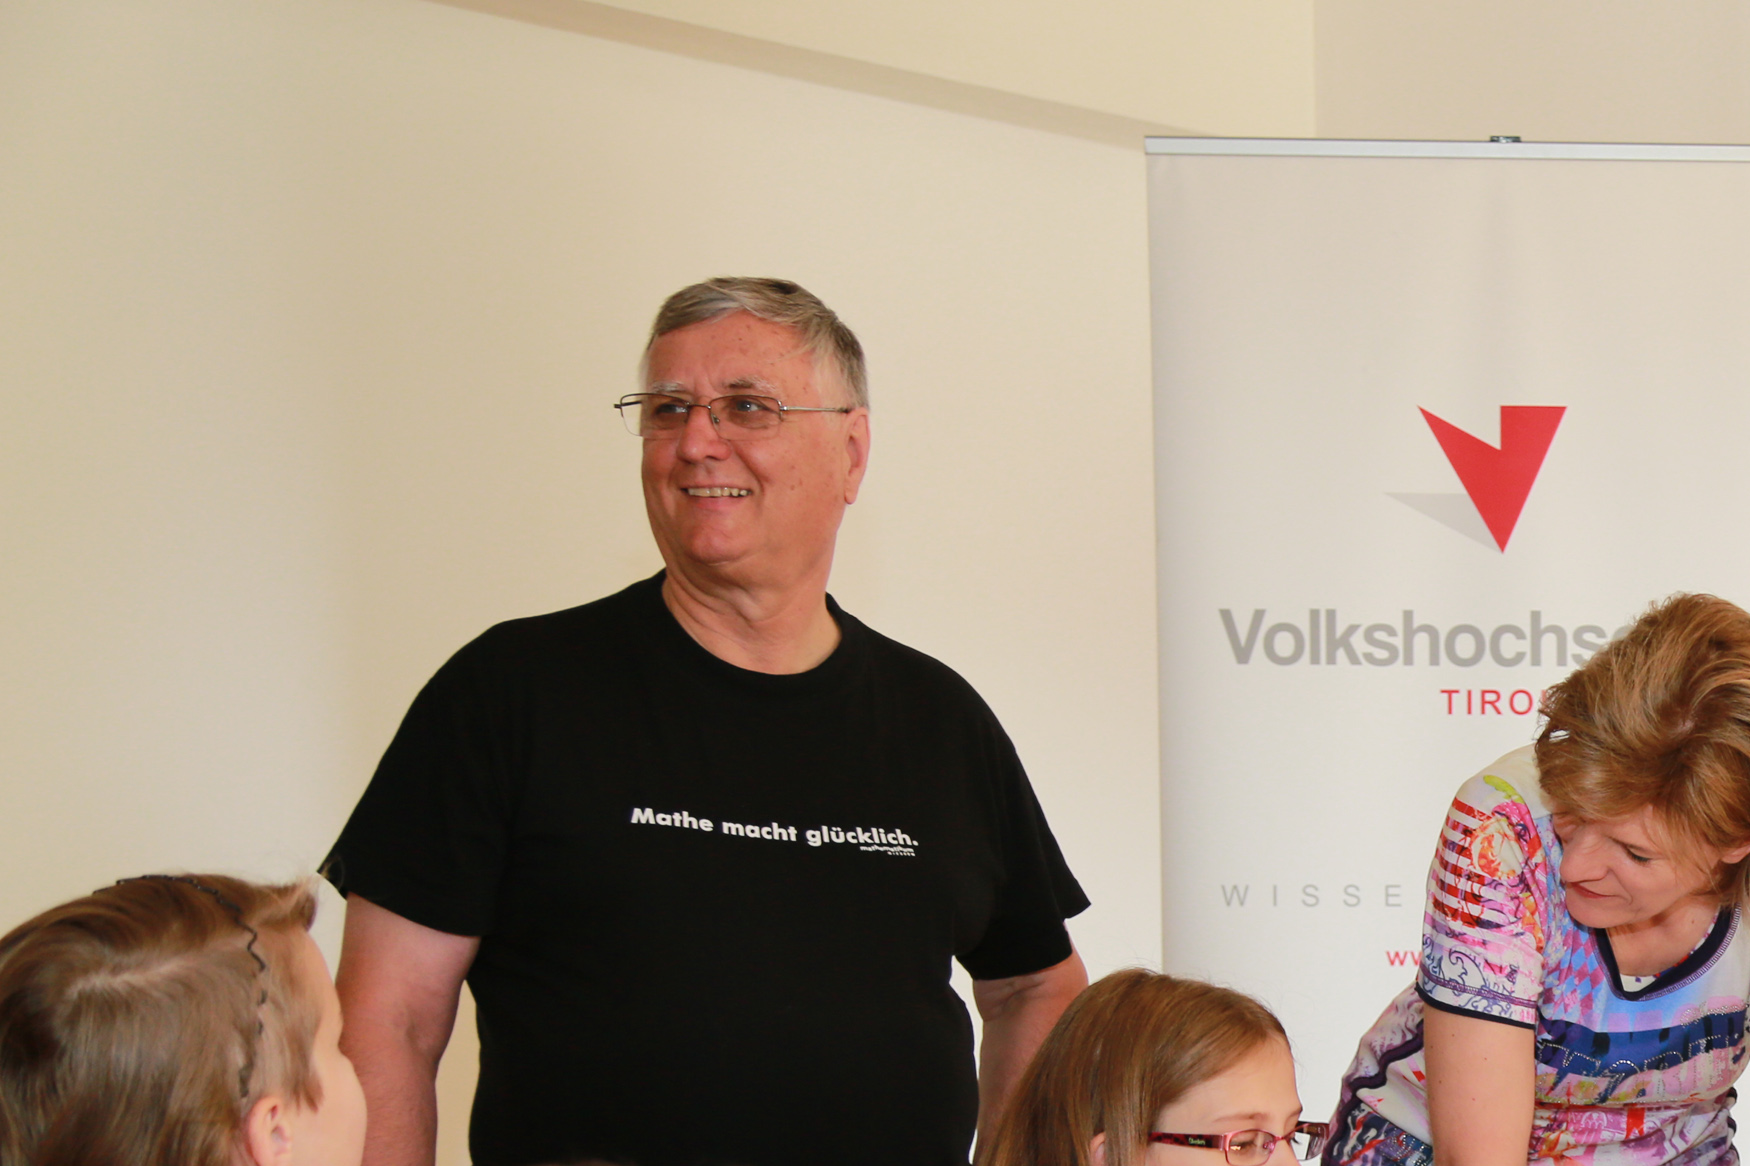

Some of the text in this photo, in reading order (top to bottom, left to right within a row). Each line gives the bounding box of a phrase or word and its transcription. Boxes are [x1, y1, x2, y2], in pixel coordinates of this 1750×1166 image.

[630, 807, 919, 847] Mathe macht glücklich.
